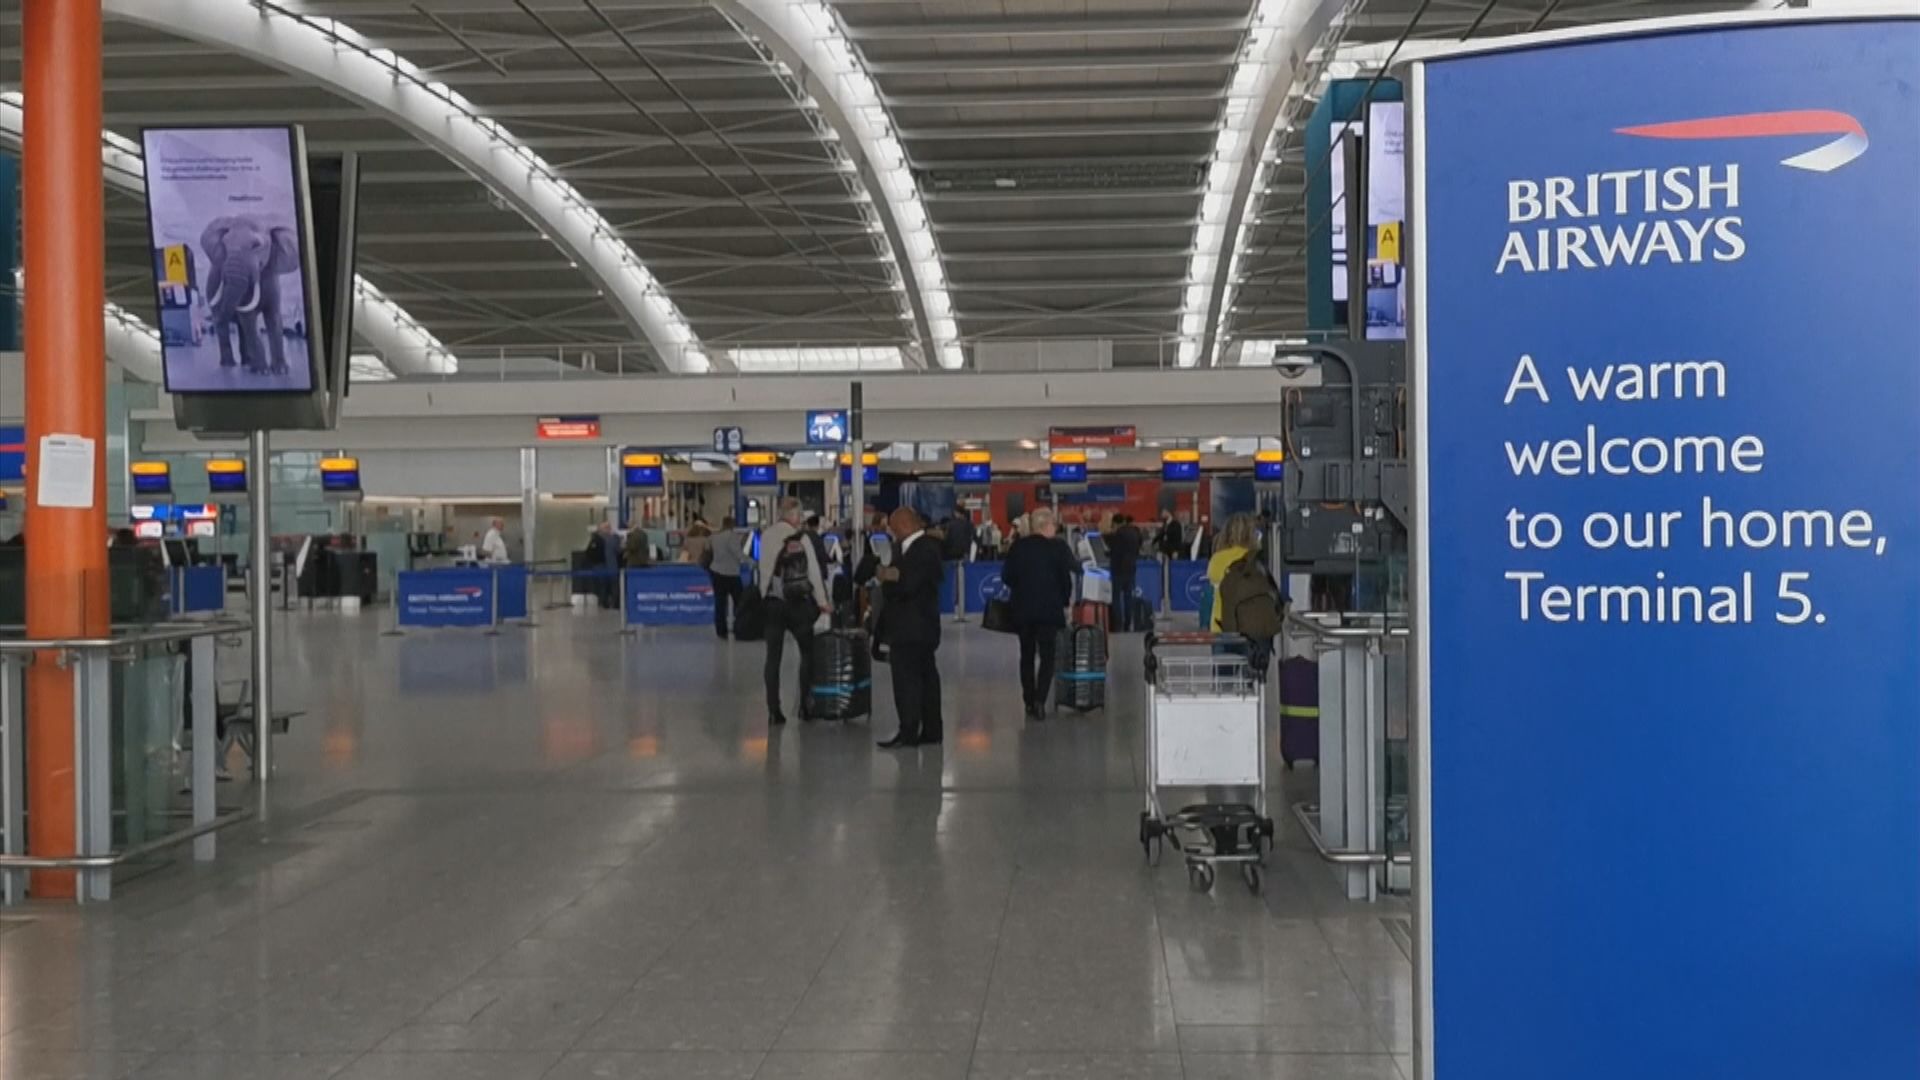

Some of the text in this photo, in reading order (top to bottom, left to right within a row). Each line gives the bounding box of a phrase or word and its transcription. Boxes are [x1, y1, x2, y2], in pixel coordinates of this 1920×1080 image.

[1507, 163, 1740, 223] BRITISH
[169, 252, 182, 267] A
[1381, 228, 1394, 244] A
[1496, 216, 1747, 273] AIRWAYS
[1503, 354, 1727, 404] A warm
[1503, 424, 1765, 477] welcome
[1505, 496, 1887, 556] to our home,
[1504, 571, 1827, 625] Terminal 5.
